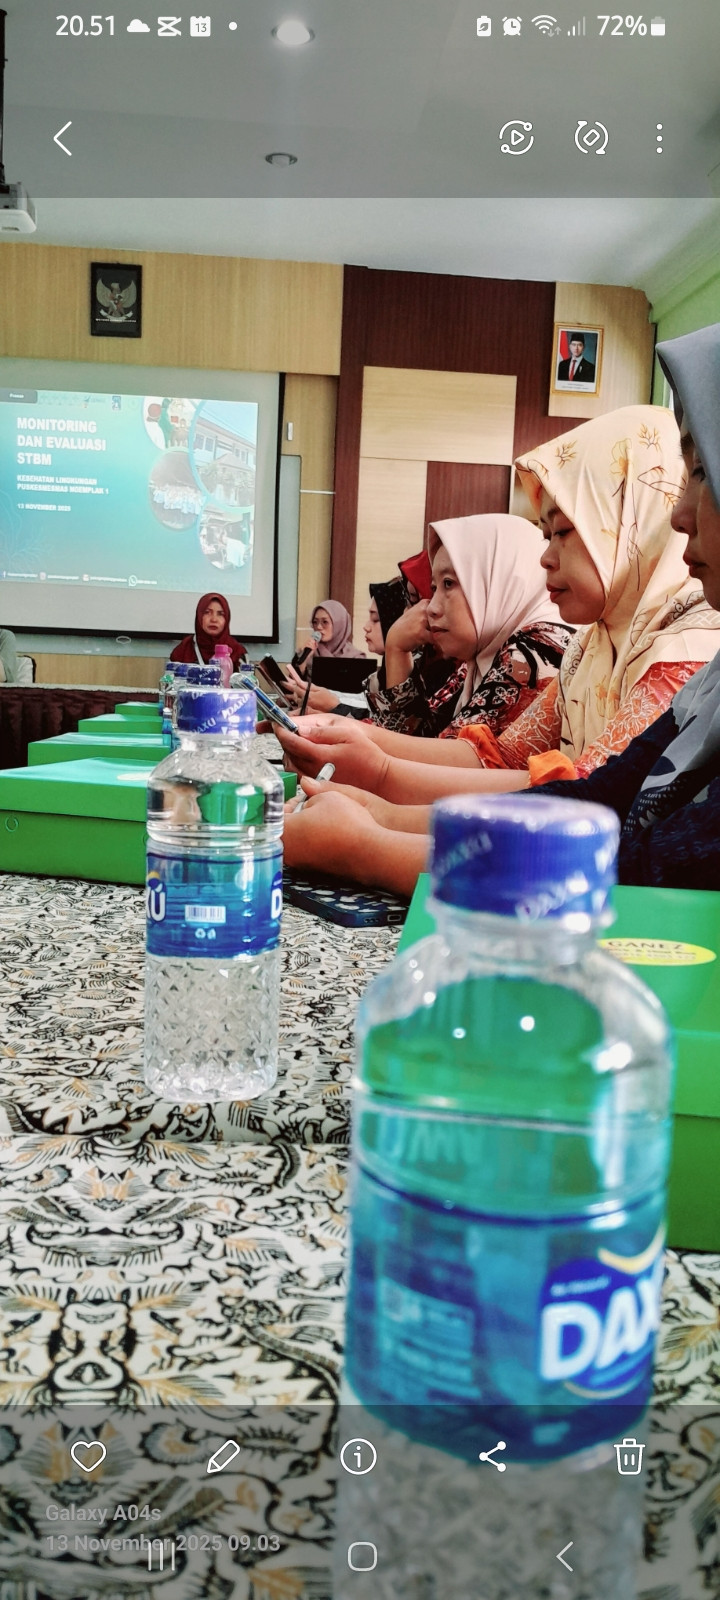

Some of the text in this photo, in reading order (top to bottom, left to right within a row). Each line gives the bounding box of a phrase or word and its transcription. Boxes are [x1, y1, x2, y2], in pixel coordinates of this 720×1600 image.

[17, 417, 97, 433] MONITORING
[17, 434, 107, 451] DAN EVALUASI
[17, 452, 52, 466] STBM
[17, 474, 55, 483] KESEHATAN
[25, 503, 57, 511] NOVEMBER
